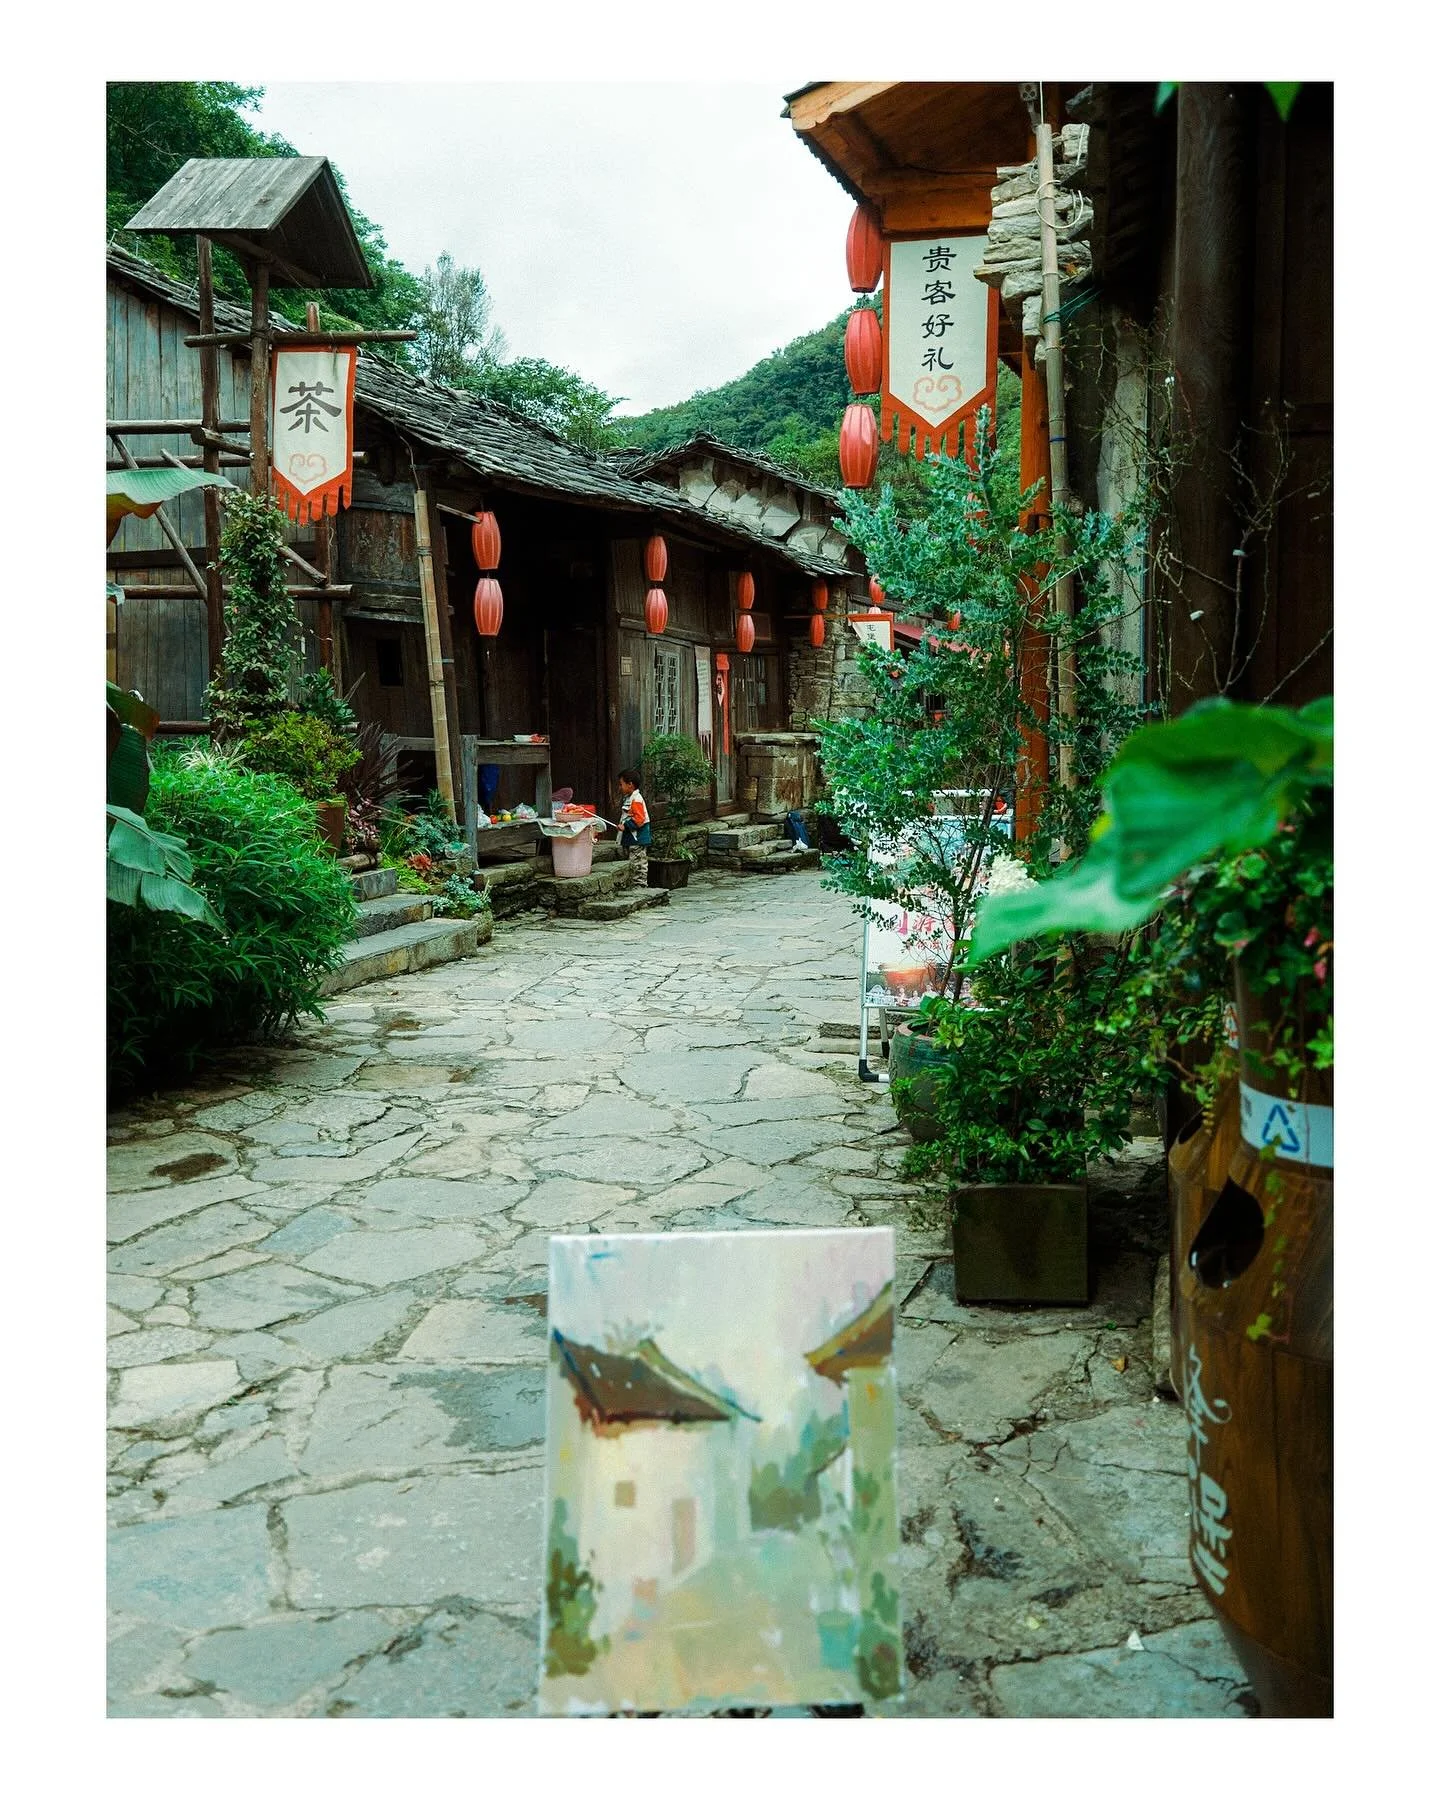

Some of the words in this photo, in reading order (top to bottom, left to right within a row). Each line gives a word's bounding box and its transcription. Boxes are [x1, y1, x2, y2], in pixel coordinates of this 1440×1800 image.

[921, 246, 957, 372] 贵客好礼
[280, 381, 342, 434] 茶
